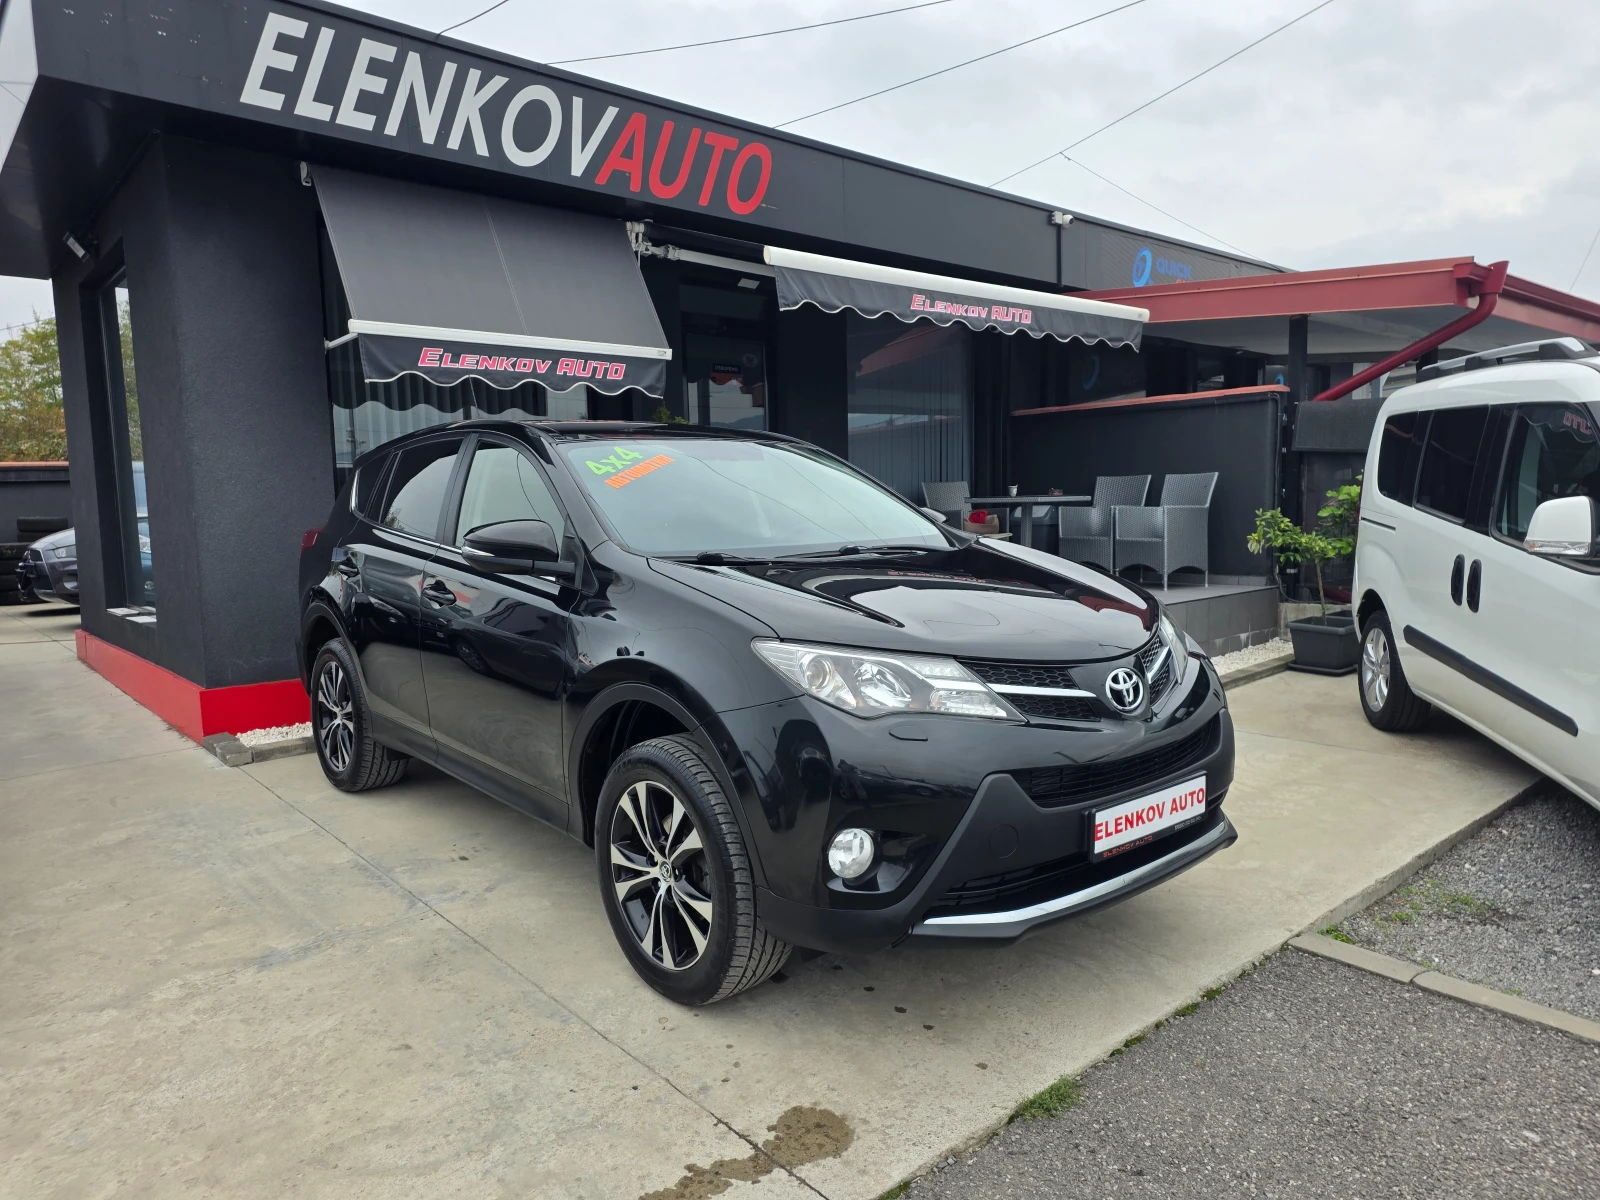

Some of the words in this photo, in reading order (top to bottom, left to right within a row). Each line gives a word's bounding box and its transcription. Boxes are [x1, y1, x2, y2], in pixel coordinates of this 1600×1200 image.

[1156, 257, 1192, 280] QUICK
[910, 294, 988, 318] ELENKOV
[991, 305, 1032, 324] AUTO
[418, 347, 552, 373] ELENKOV
[557, 358, 626, 380] AUTO
[1094, 801, 1166, 842] ELENKOV
[1169, 787, 1205, 816] AUTO
[1135, 835, 1153, 846] AUTO
